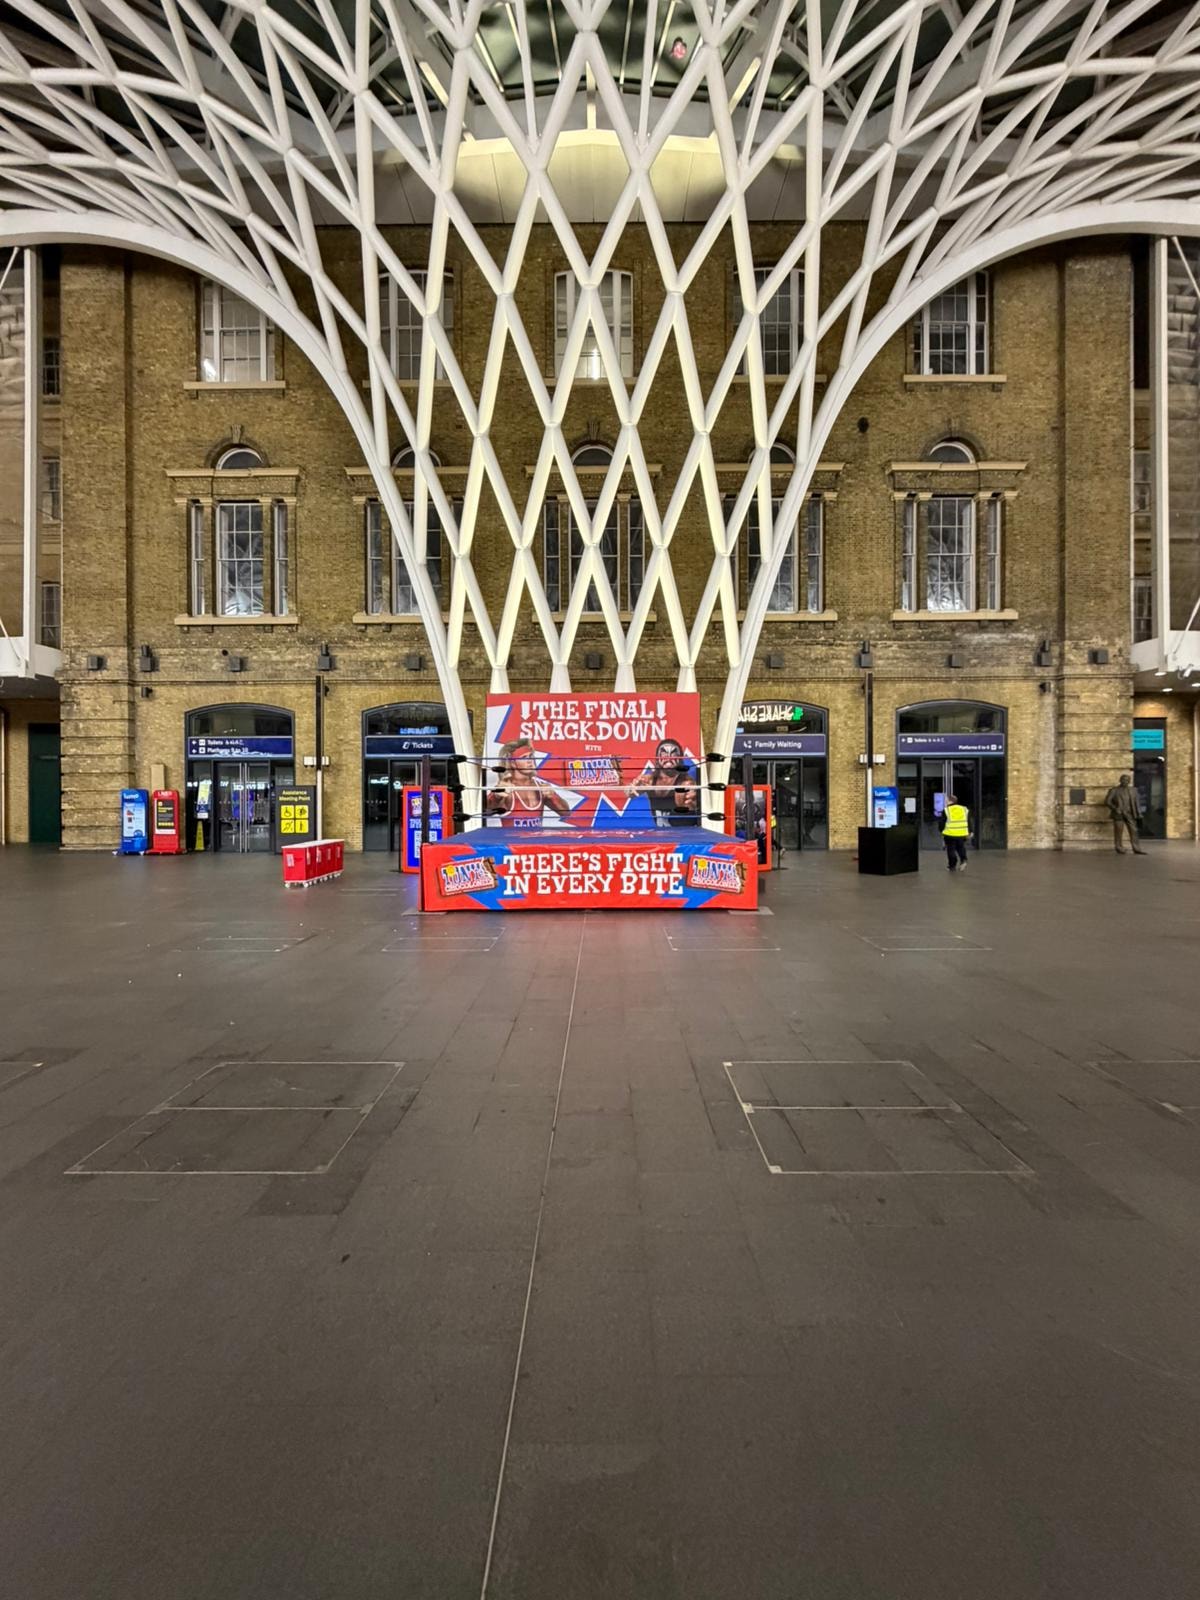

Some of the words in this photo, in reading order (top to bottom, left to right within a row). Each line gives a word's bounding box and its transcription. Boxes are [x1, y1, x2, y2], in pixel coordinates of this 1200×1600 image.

[532, 700, 580, 720] THE
[583, 699, 655, 720] FINAL
[519, 719, 668, 742] SNACKDOWN
[411, 741, 434, 749] Tickets
[584, 743, 603, 752] WITH
[754, 740, 776, 749] Family
[776, 740, 803, 749] Waiting
[503, 851, 601, 875] THERE'S
[606, 852, 684, 873] FIGHT
[503, 874, 531, 895] IN
[536, 873, 614, 895] EVERY
[620, 873, 684, 895] BITE
